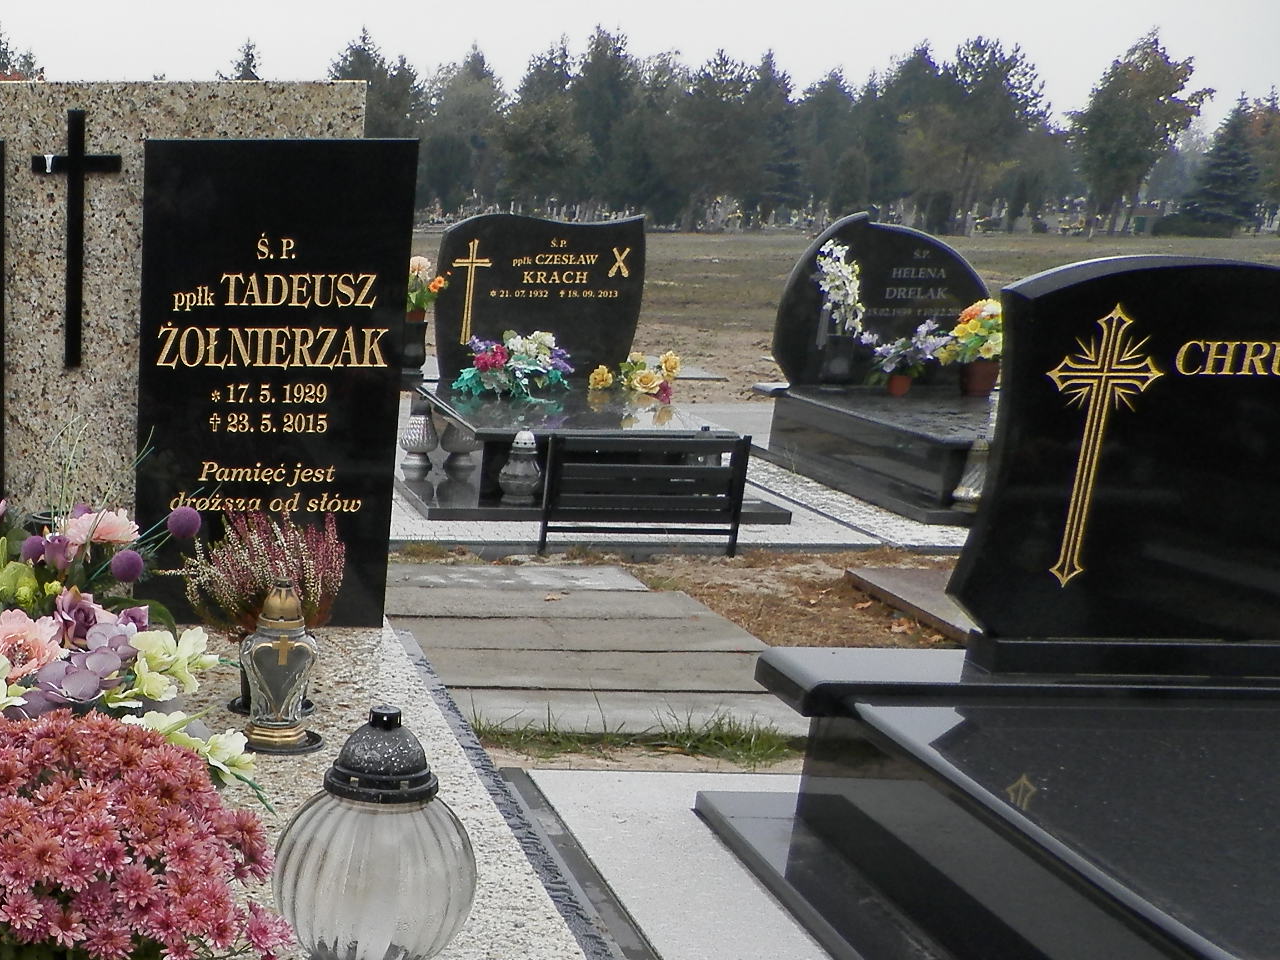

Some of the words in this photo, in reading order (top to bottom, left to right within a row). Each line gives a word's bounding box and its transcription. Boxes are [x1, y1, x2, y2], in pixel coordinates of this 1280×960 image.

[280, 238, 296, 260] P.
[535, 253, 599, 265] CZESŁAW
[522, 271, 588, 284] KRACH
[891, 267, 947, 279] HELENA
[173, 285, 216, 311] ppłk
[220, 271, 377, 310] TADEUSZ
[528, 290, 549, 298] 1932
[598, 290, 618, 298] 2013
[885, 287, 949, 300] DRELAK
[156, 321, 389, 371] ŻOŁNIERZAK
[226, 383, 253, 404] 17.
[259, 383, 276, 404] 5.
[282, 383, 328, 404] 1929
[227, 412, 254, 433] 23.
[260, 412, 277, 433] 5.
[282, 412, 328, 433] 2015
[198, 461, 286, 485] Pamięć
[286, 463, 337, 487] jest
[269, 492, 301, 512] od
[306, 492, 362, 513] słów
